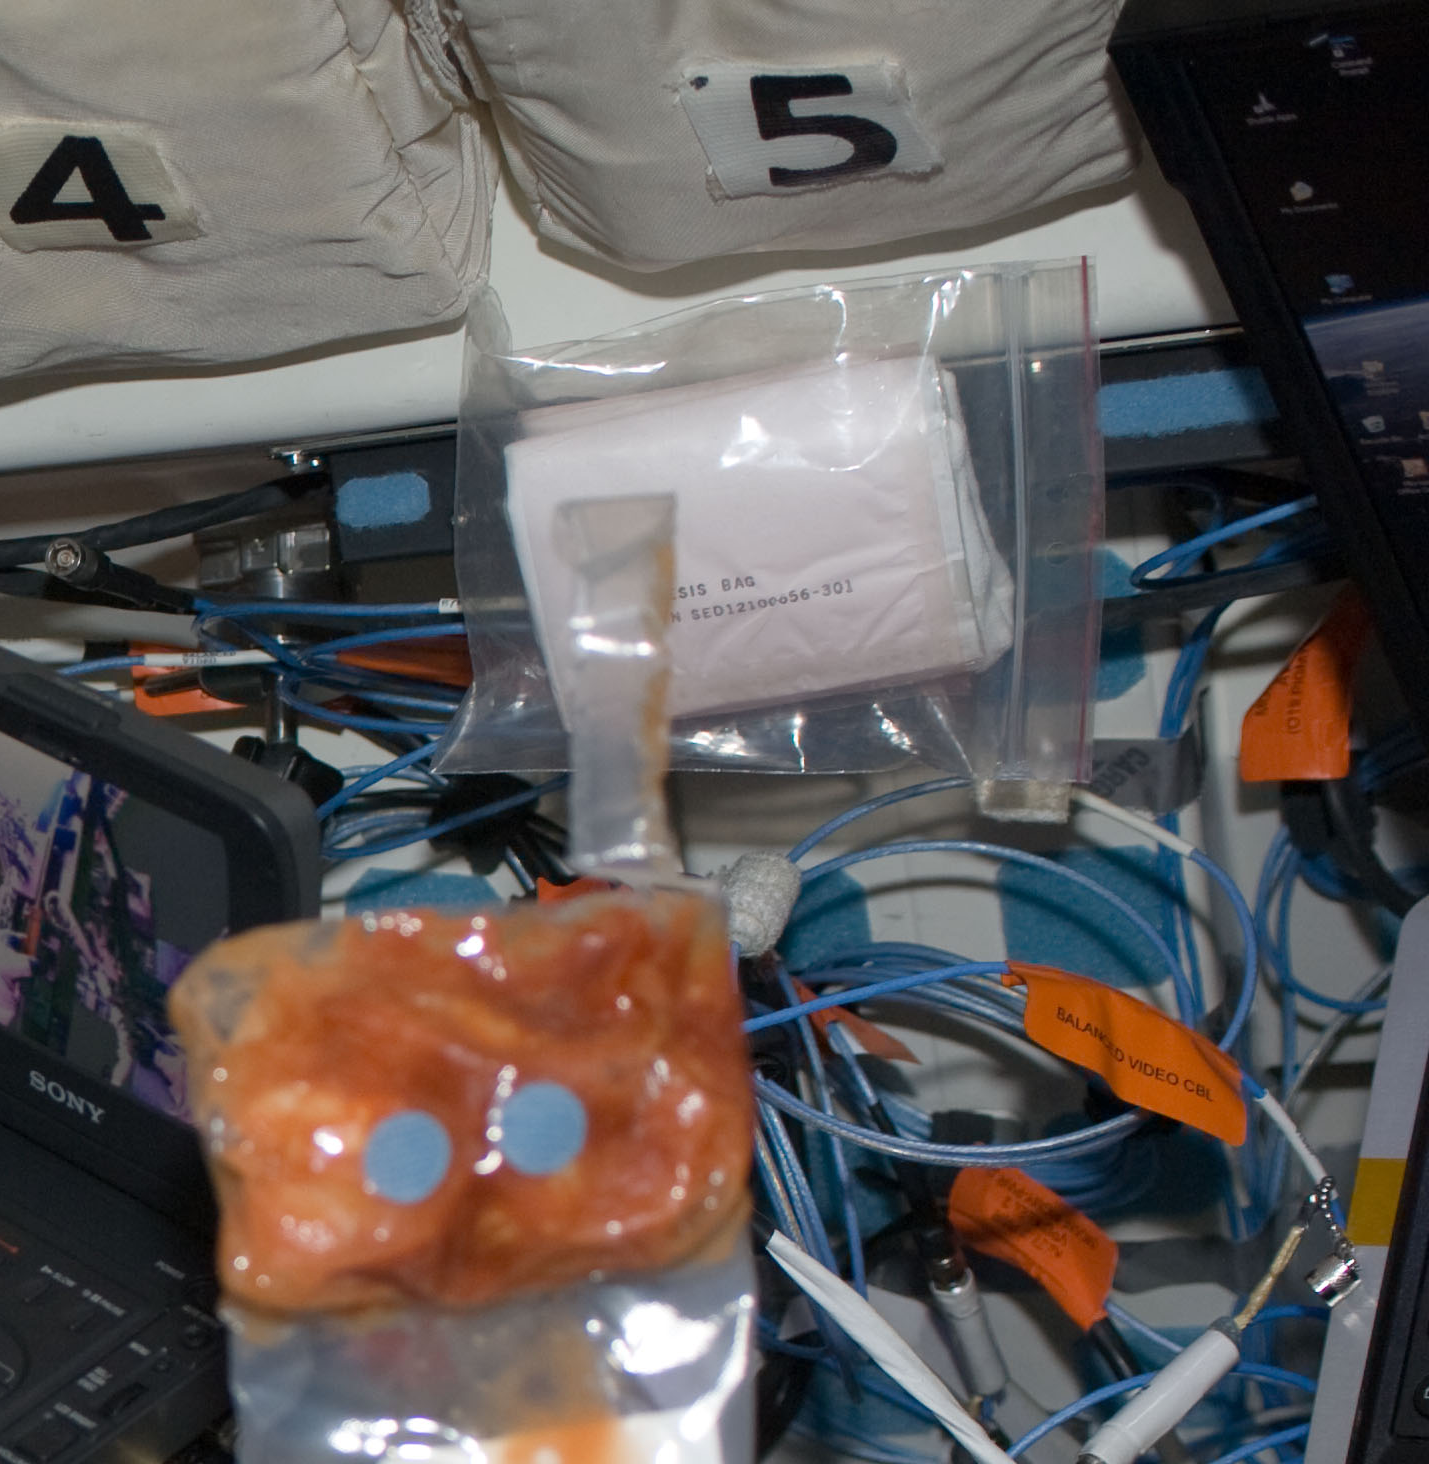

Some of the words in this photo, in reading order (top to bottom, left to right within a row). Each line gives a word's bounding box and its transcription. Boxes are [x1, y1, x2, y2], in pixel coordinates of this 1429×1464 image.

[749, 72, 898, 189] 5
[8, 135, 166, 242] 4
[721, 575, 756, 592] BAG
[28, 1069, 106, 1124] SONY
[1055, 1006, 1125, 1063] BALANCED
[1128, 1055, 1180, 1086] VIDEO
[1183, 1078, 1214, 1102] CBL
